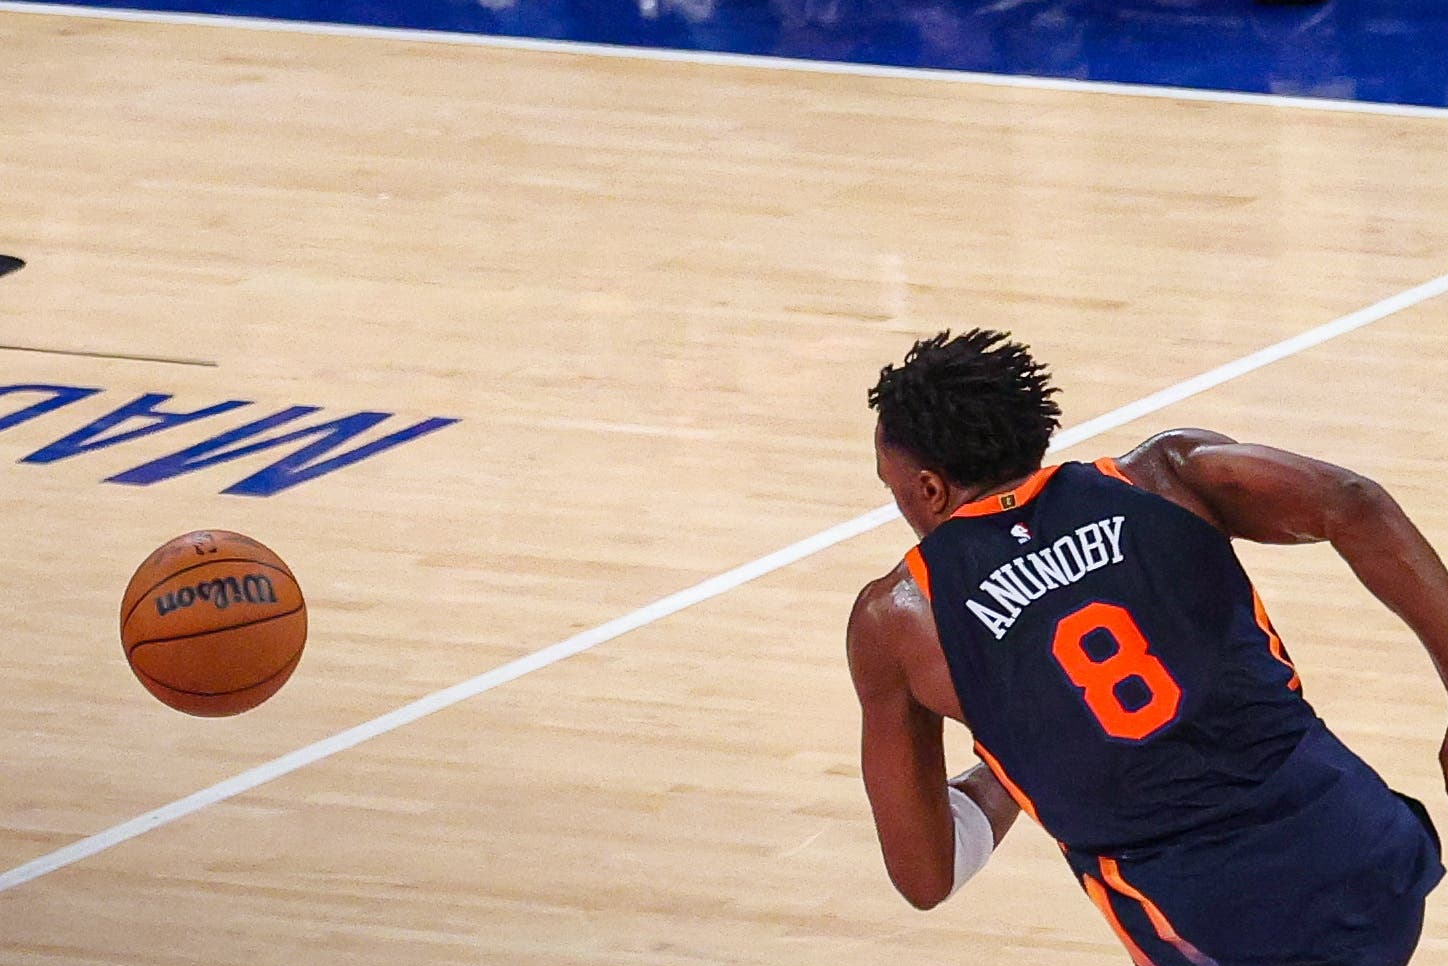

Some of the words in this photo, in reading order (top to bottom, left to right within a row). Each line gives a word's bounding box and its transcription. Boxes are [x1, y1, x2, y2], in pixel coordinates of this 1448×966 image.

[156, 573, 278, 616] Wilson
[965, 515, 1126, 641] ANUNOBY
[1051, 600, 1184, 742] 8
